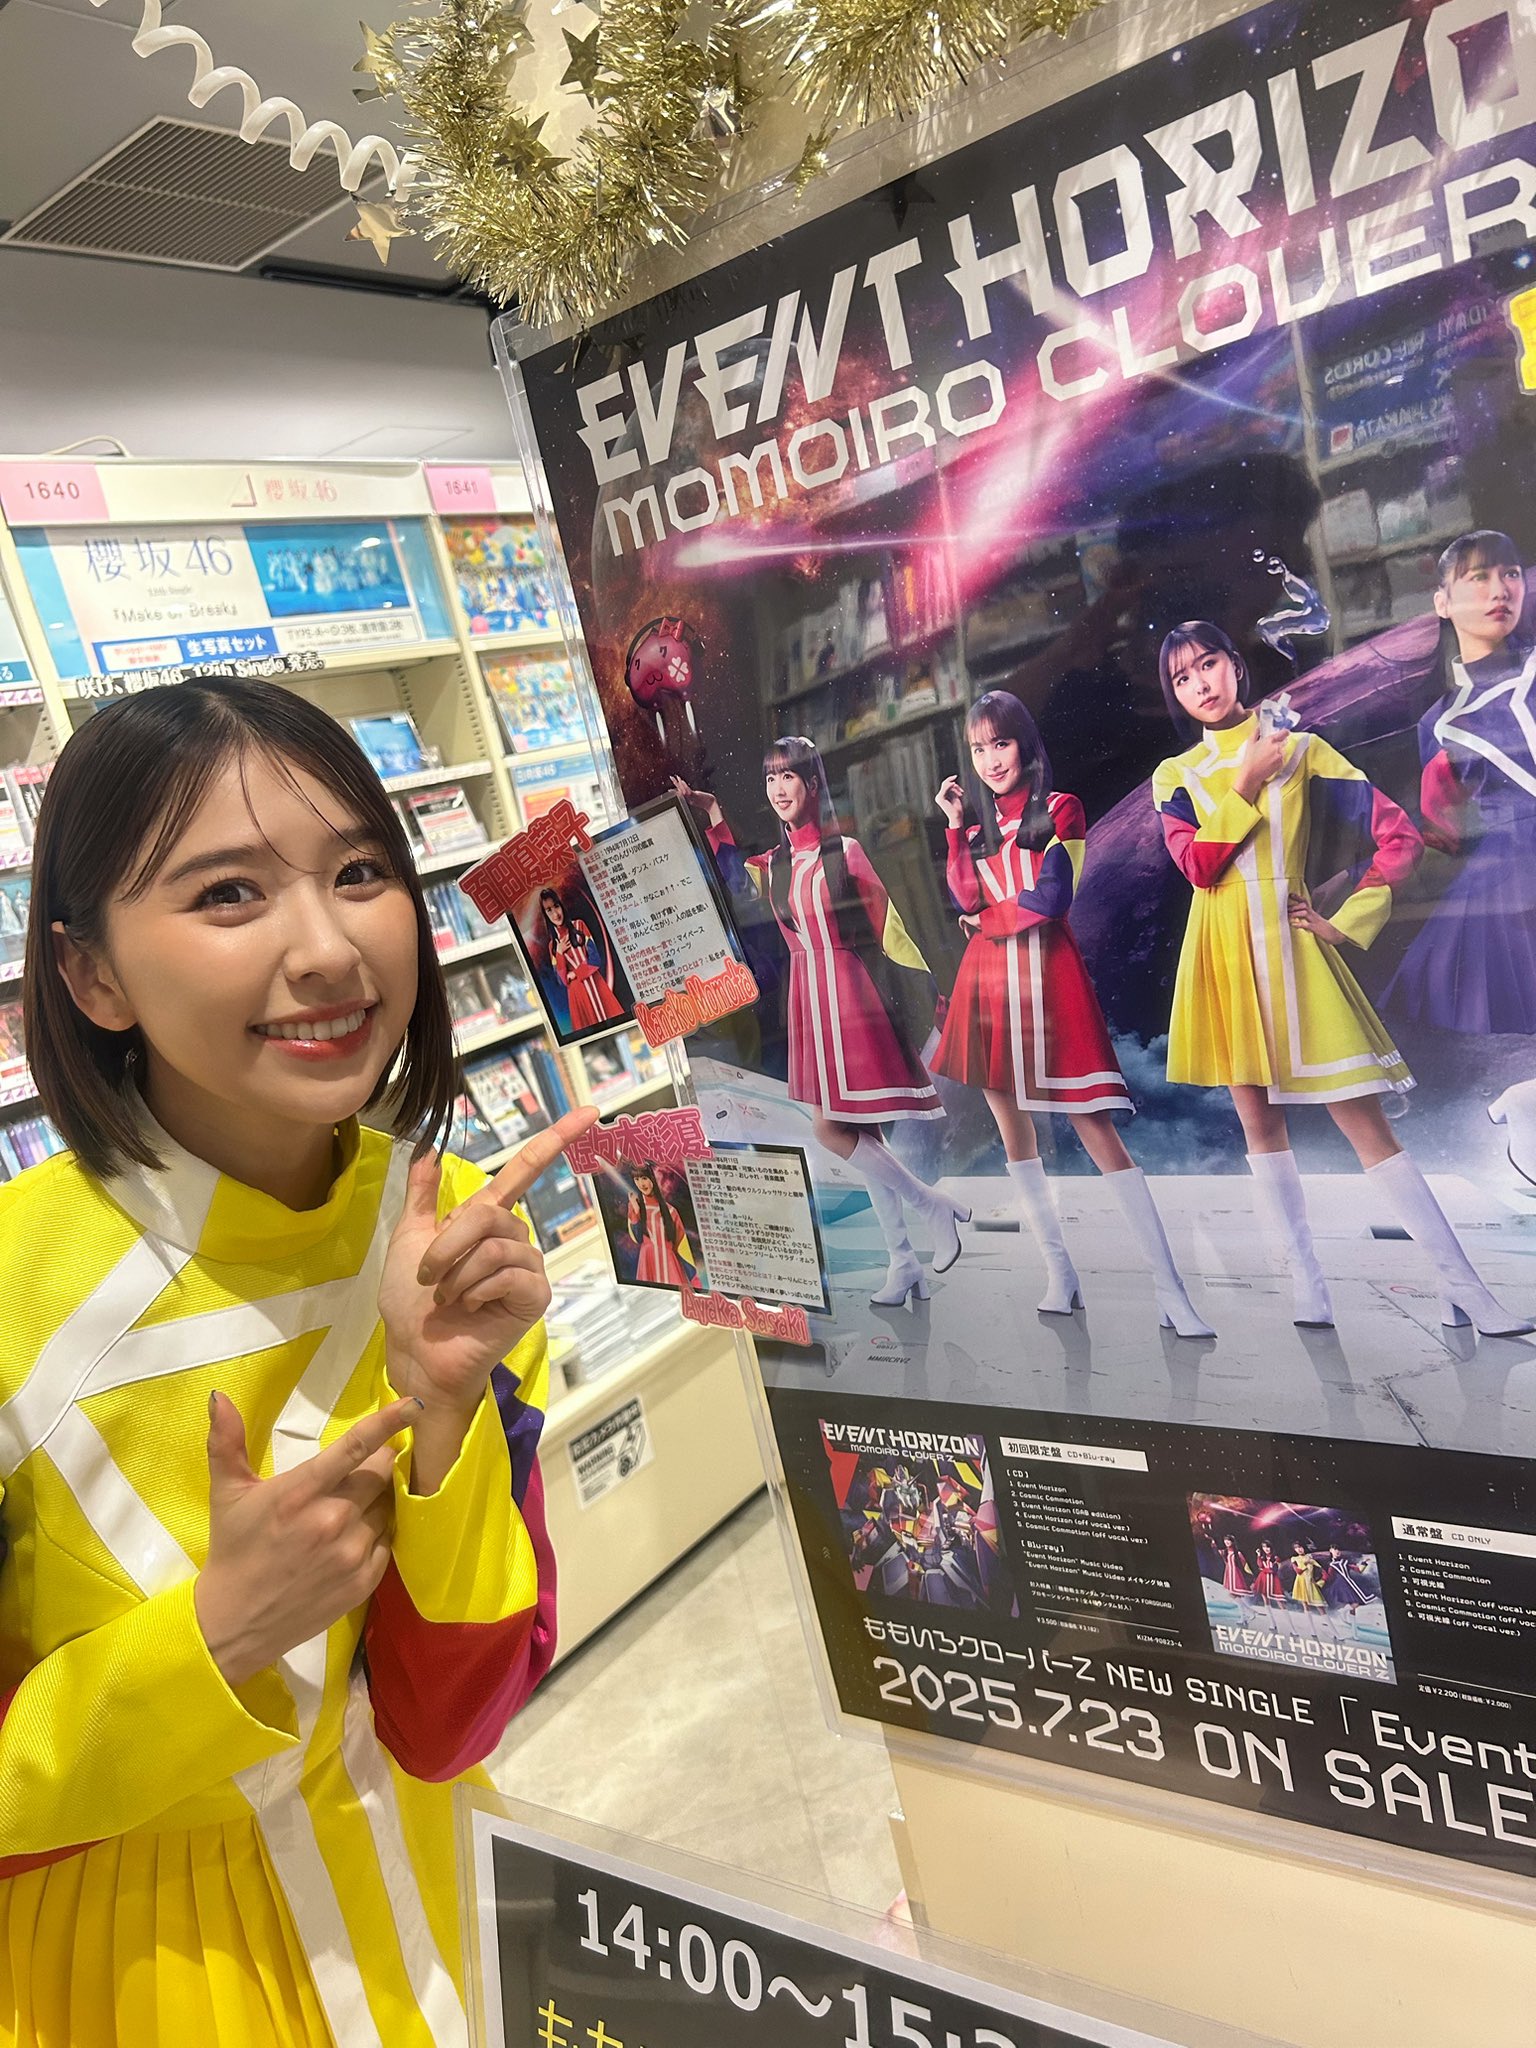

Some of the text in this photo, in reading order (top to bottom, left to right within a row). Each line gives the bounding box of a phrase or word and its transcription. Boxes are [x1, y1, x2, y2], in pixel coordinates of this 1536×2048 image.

[577, 241, 923, 484] EVENT
[602, 366, 1006, 556] MOMOIRO
[24, 482, 80, 500] 1640
[445, 481, 478, 495] 1641
[83, 535, 233, 583] 櫻坂46
[187, 634, 267, 658] 生写真セット
[459, 799, 594, 924] 百田夏菜子
[611, 915, 627, 926] ちゃん
[622, 943, 637, 953] てない
[635, 957, 758, 1046] Kanako Momota
[566, 1111, 713, 1173] 佐々木彩夏
[682, 1287, 810, 1345] Ayaka Sasaki
[824, 1422, 983, 1457] EVENT HORIZON
[1008, 1440, 1062, 1459] 初回限定盤
[850, 1444, 900, 1457] MOMOIRO
[945, 1455, 956, 1463] Z
[1017, 1480, 1036, 1489] Event
[1038, 1483, 1066, 1493] Horizon
[1019, 1490, 1044, 1500] Cosmic
[1045, 1494, 1084, 1506] Commotion
[1021, 1500, 1041, 1510] Event
[1043, 1503, 1070, 1514] Horizon
[1023, 1511, 1043, 1520] Event
[1044, 1514, 1073, 1524] Horizon
[1074, 1518, 1089, 1527] (off
[1090, 1520, 1110, 1529] vocal
[1025, 1521, 1049, 1531] Cosmic
[1051, 1525, 1090, 1537] Commotion
[1091, 1530, 1105, 1539] (off
[1107, 1532, 1128, 1542] vocal
[1402, 1522, 1491, 1545] 通常盤 CD ONLY
[1080, 1558, 1100, 1568] Music
[1102, 1561, 1123, 1571] Video
[1408, 1554, 1432, 1564] Event
[1434, 1558, 1470, 1570] Horizon
[1082, 1568, 1102, 1578] Music
[1104, 1571, 1125, 1582] Video
[1127, 1576, 1170, 1589] メイキング映像
[1409, 1565, 1439, 1577] Cosmic
[1442, 1571, 1490, 1585] Commotion
[1412, 1577, 1445, 1589] 可視光線
[1413, 1589, 1438, 1600] Event
[1440, 1594, 1475, 1605] Horizon
[1478, 1600, 1495, 1609] (off
[1497, 1603, 1522, 1613] vocal
[1415, 1601, 1445, 1612] Cosmic
[1448, 1607, 1495, 1620] Commotion
[1498, 1615, 1516, 1624] (off
[1418, 1612, 1449, 1624] 可視光線
[1452, 1618, 1469, 1628] (off
[1472, 1622, 1496, 1632] vocal
[1499, 1626, 1520, 1637] ver.)
[1216, 1625, 1388, 1669] EVENT HORIZON
[863, 1616, 1096, 1681] ももいろクローバーZ
[1105, 1661, 1174, 1697] NEW
[1186, 1677, 1315, 1725] SINGLE
[1219, 1641, 1298, 1664] MOMOIRO
[1375, 1667, 1391, 1681] Z
[873, 1656, 1536, 1848] 2025.7.23 ON SALE
